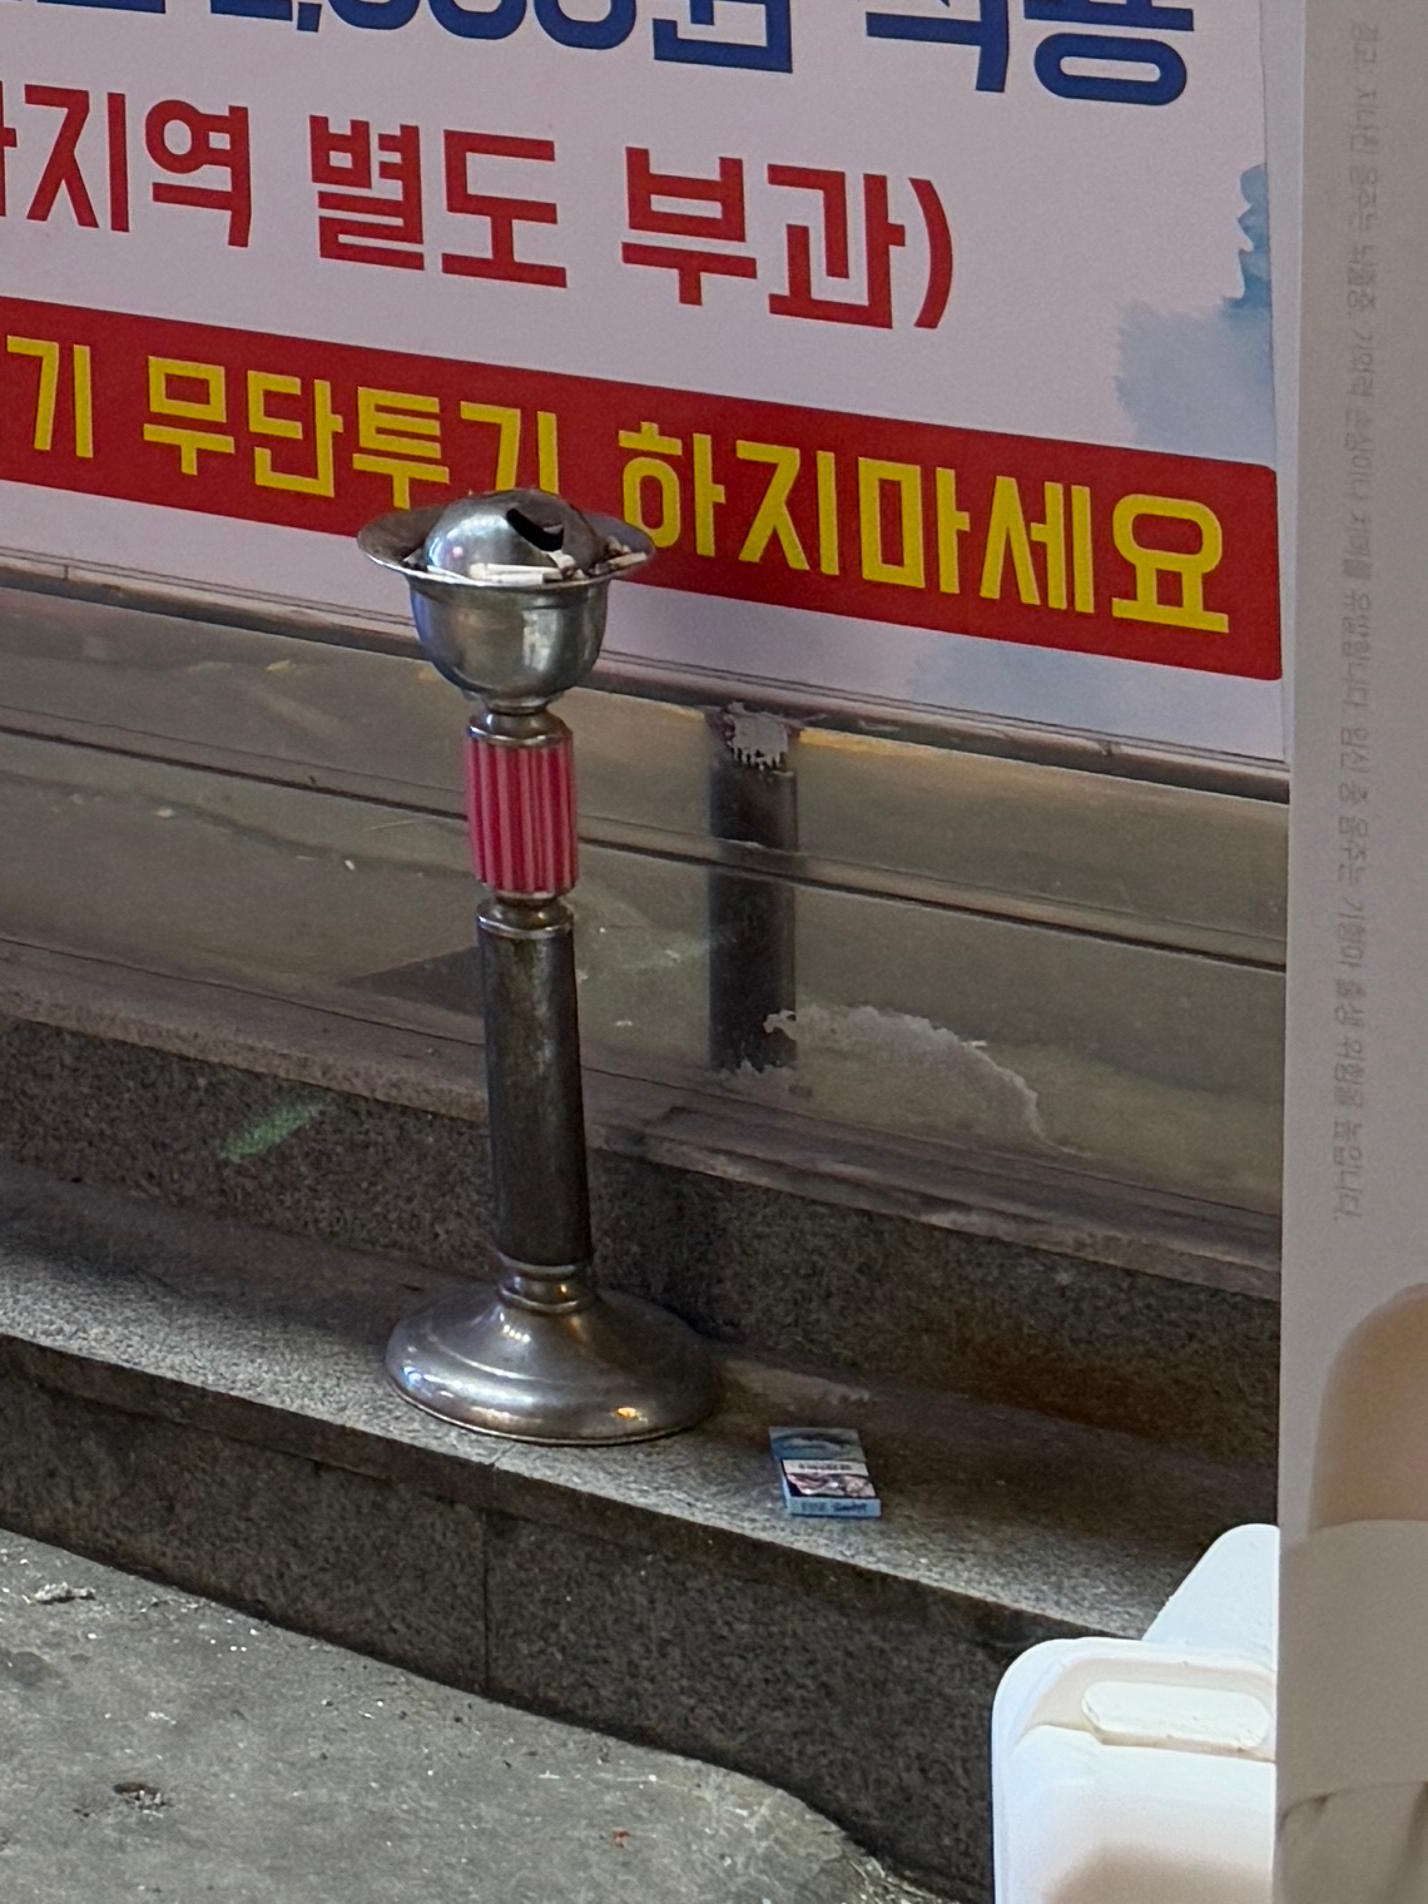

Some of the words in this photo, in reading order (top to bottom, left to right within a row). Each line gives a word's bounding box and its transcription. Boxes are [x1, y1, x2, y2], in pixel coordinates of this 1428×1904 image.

[309, 113, 568, 289] 별도
[621, 146, 954, 330] 부과)
[143, 355, 560, 510] 무단투기
[618, 421, 1230, 634] 하지마세요
